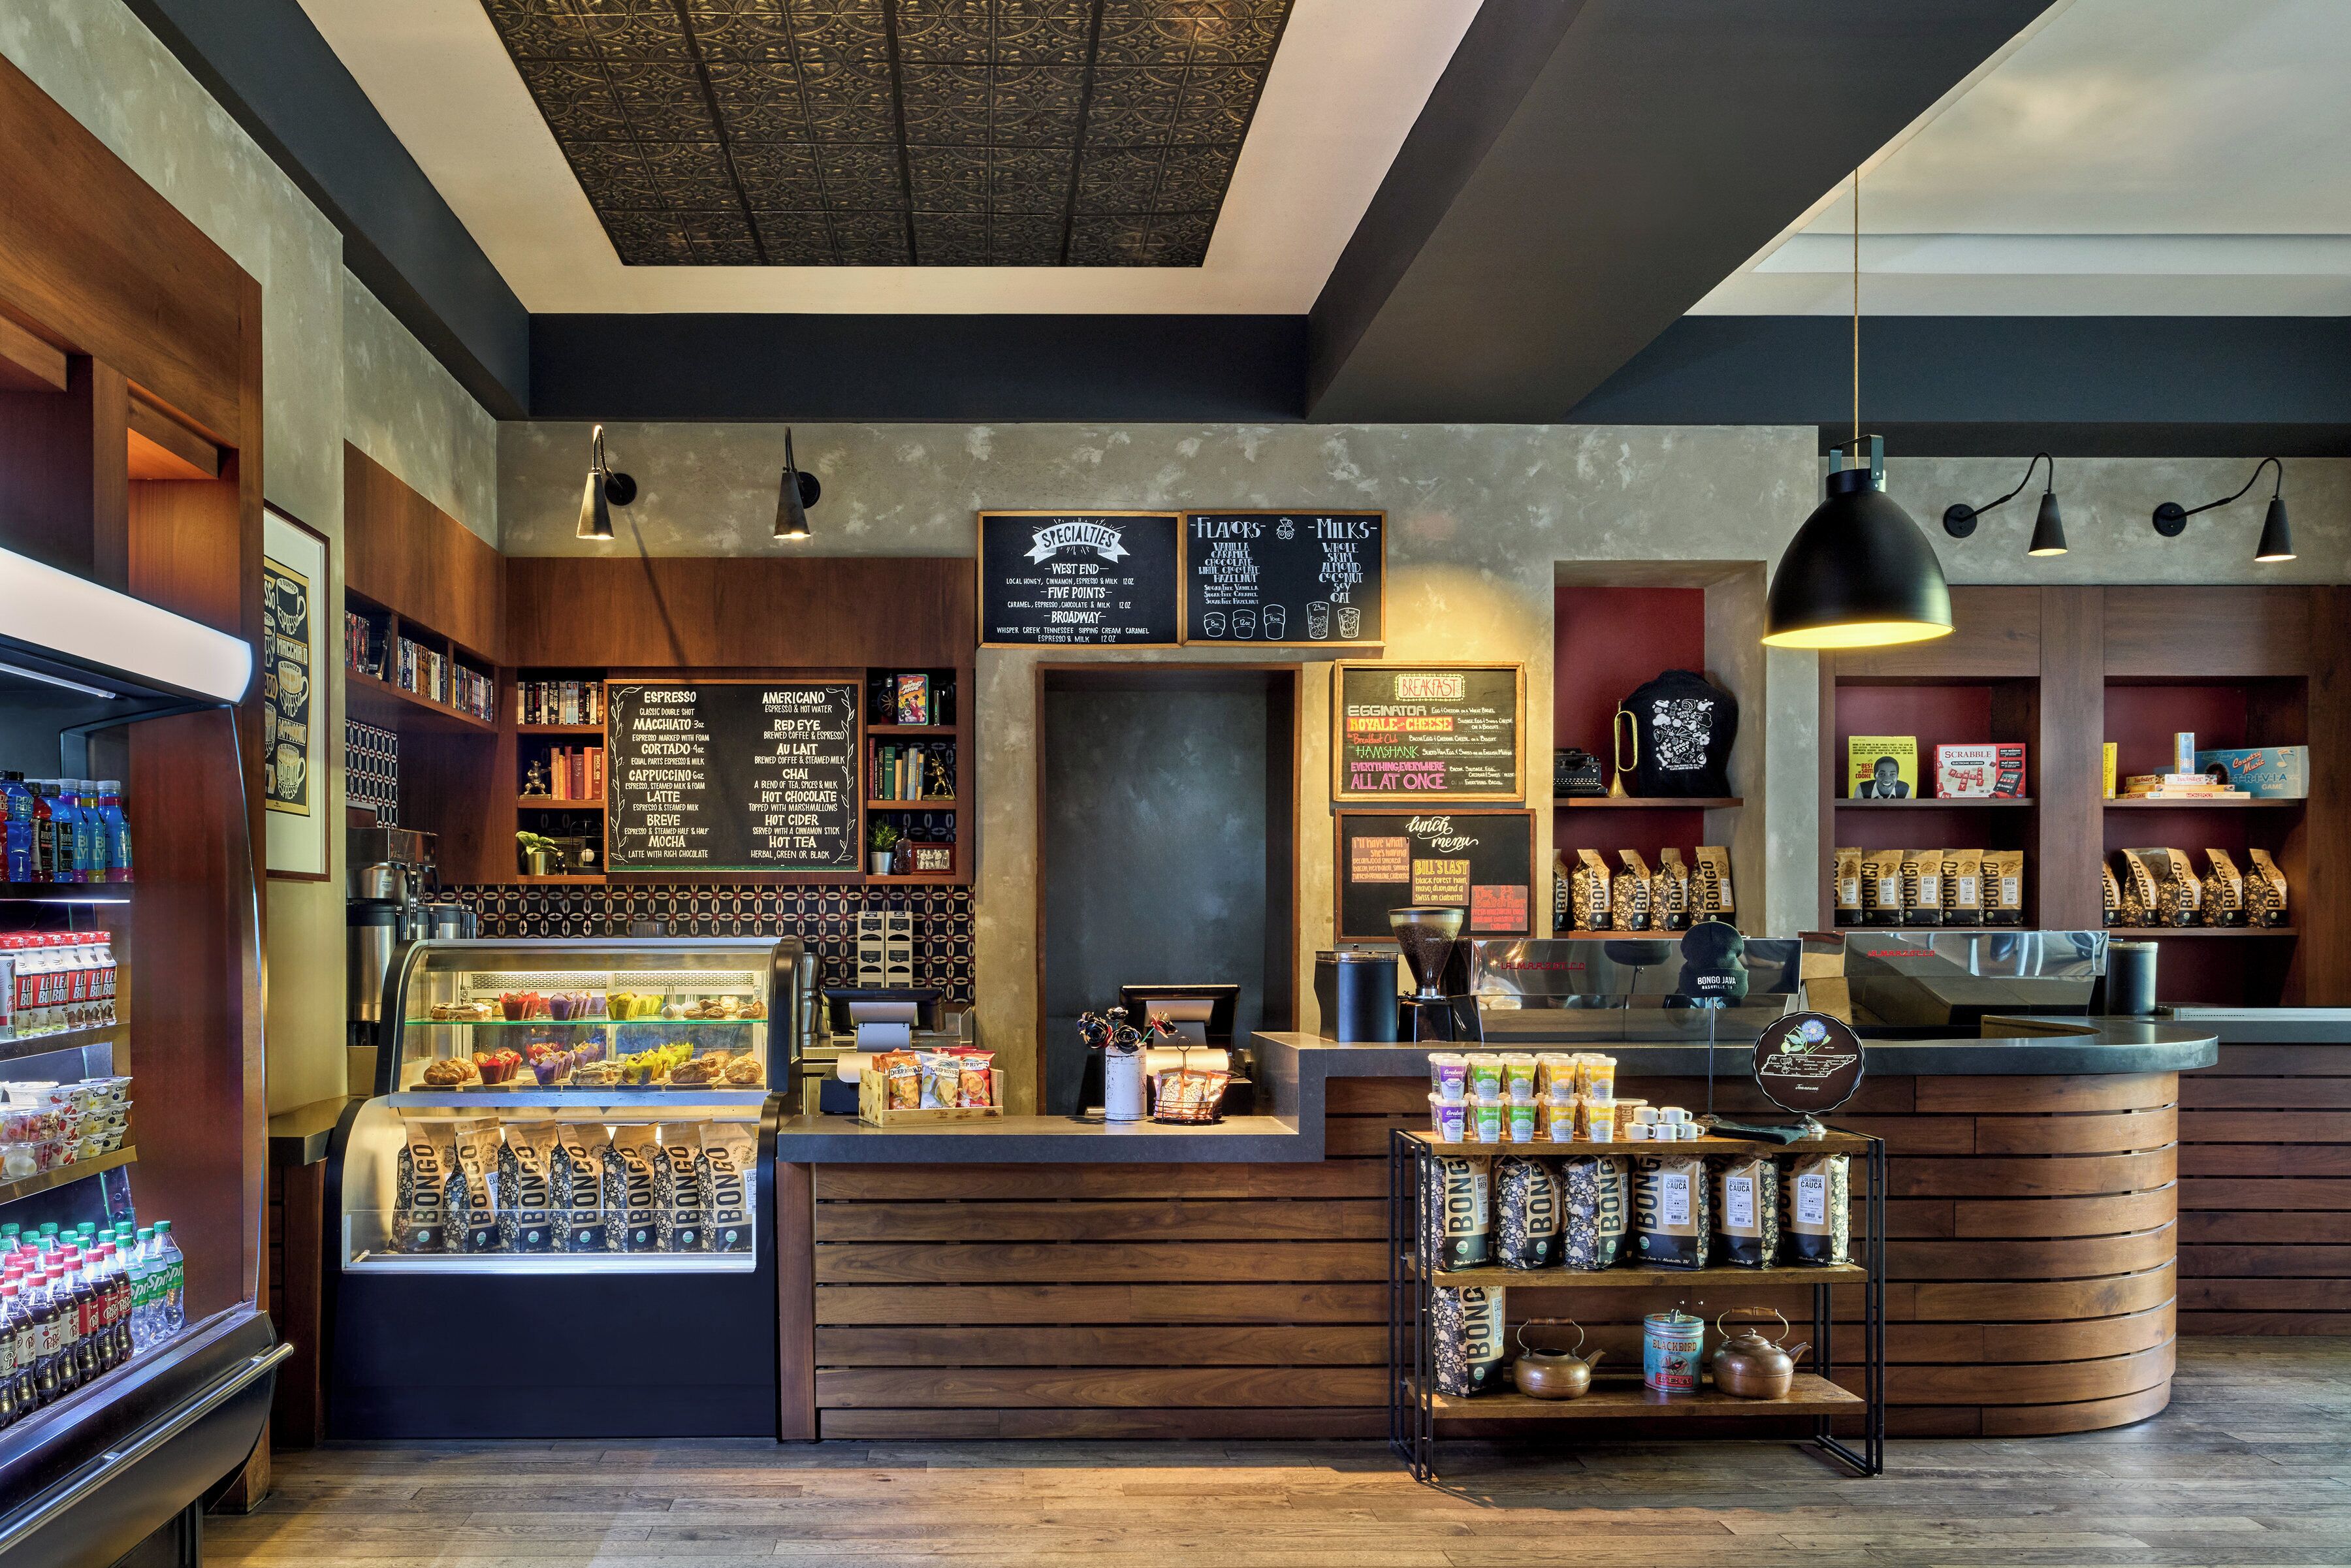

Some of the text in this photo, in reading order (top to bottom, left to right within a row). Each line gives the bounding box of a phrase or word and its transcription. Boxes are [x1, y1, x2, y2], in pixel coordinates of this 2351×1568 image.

[1042, 526, 1115, 548] SPECIALTIES
[1213, 543, 1250, 551] VANILLA
[1322, 543, 1358, 552] WHOLE
[1328, 553, 1352, 562] SKIM
[1051, 564, 1099, 574] WEST END
[1321, 562, 1361, 573] ALMOND
[1213, 574, 1257, 583] HAZELNUT
[1319, 573, 1363, 583] COCONUT
[283, 579, 297, 592] OUNCES
[1334, 583, 1351, 592] SOY
[1048, 587, 1106, 598] FIVE POINTS
[1330, 592, 1350, 603] OAT
[278, 604, 299, 635] ESPRESSO
[1051, 611, 1100, 624] BROADWAY
[1403, 679, 1458, 697] BREAKFAST
[644, 691, 697, 703] ESPRESSO
[762, 692, 825, 703] AMERICANO
[280, 691, 302, 717] ESPRESSO
[1348, 705, 1426, 716] EGGINATOR
[633, 718, 692, 730] MACCHIATO
[775, 720, 820, 731] RED EYE
[1350, 718, 1398, 730] ROYALE
[1405, 718, 1451, 730] CHEESE
[278, 718, 306, 744] CAPPUCCINO
[1353, 733, 1398, 744] Breakfast Club
[641, 743, 704, 754] CORTADO 4oz
[776, 744, 818, 754] AU LAIT
[1356, 746, 1419, 756] HAMSHANK
[1676, 745, 1689, 755] EAST
[2233, 750, 2262, 768] Country
[2243, 759, 2265, 775] Music
[596, 771, 600, 780] ON
[629, 769, 691, 781] CAPPUCCINO
[782, 769, 808, 779] CHAI
[2235, 773, 2287, 783] TRIVIA
[1351, 773, 1377, 790] ALL
[1379, 773, 1399, 789] AT
[278, 783, 298, 799] ESPRESSO
[762, 791, 837, 803] HOT CHOCOLATE
[647, 792, 680, 803] LATTE
[647, 814, 680, 825] BREVE
[765, 814, 819, 825] HOT CIDER
[1405, 816, 1453, 839] lunch
[648, 835, 686, 847] MOCHA
[769, 837, 816, 848] HOT TEA
[1366, 839, 1383, 848] have
[1386, 838, 1403, 848] what
[1431, 836, 1479, 852] menu
[1415, 861, 1468, 874] BILL'S LAST
[1701, 861, 1720, 910] BONGO
[413, 1144, 440, 1223] BONGO
[460, 1145, 491, 1225] BONGO
[515, 1145, 546, 1224] BONGO
[568, 1147, 597, 1224] BONGO
[620, 1148, 651, 1224] BONGO
[668, 1147, 699, 1224] BONGO
[705, 1147, 742, 1223] BONGO
[1653, 1339, 1697, 1351] BLACKBIRD
[1658, 1375, 1690, 1384] TEA
